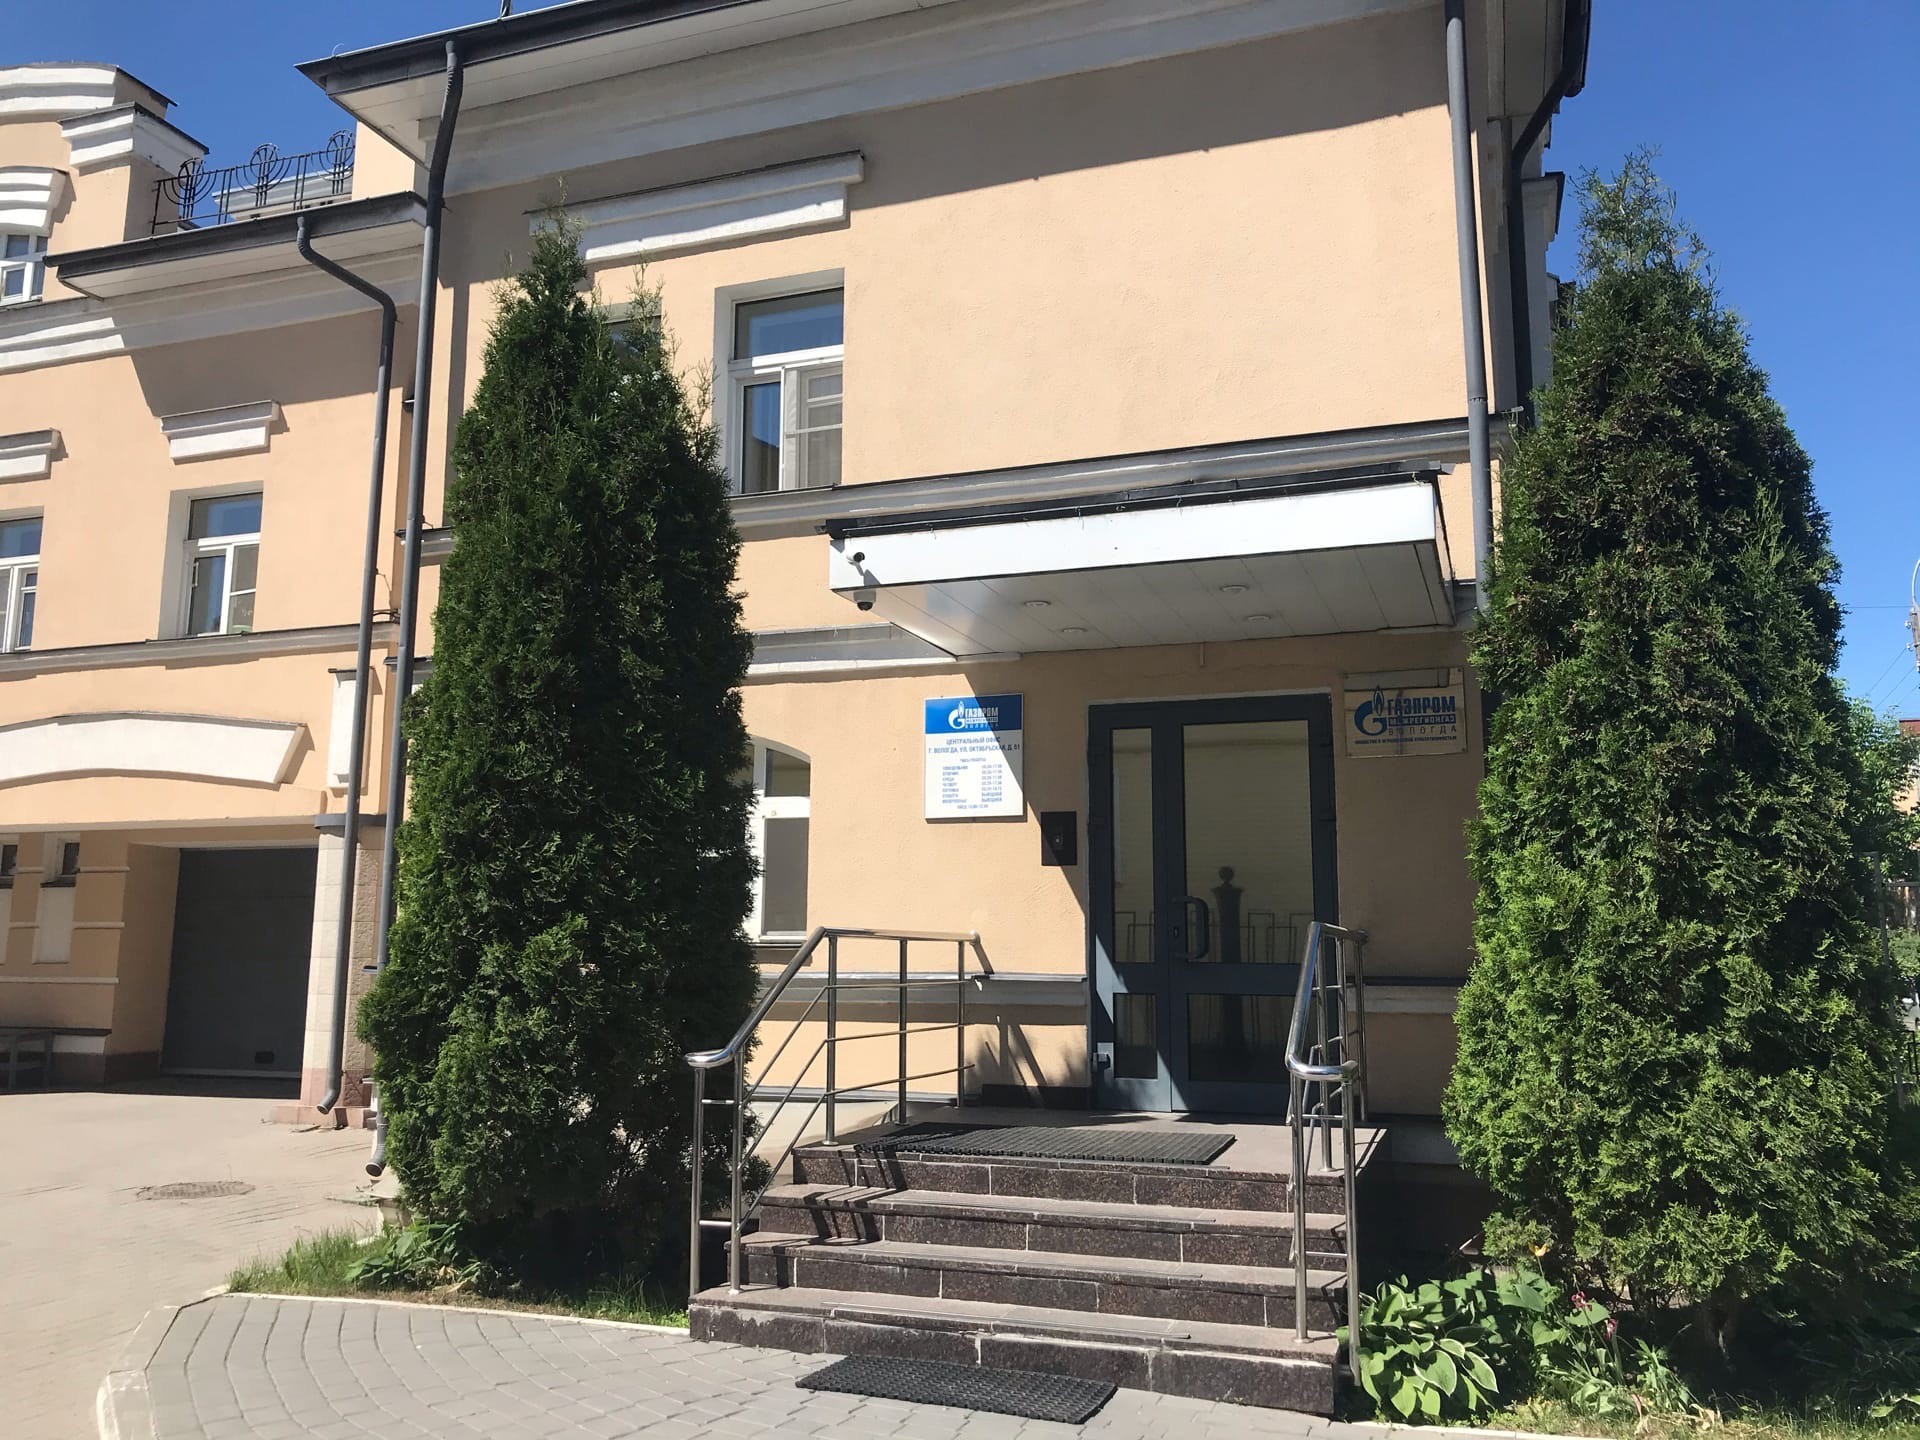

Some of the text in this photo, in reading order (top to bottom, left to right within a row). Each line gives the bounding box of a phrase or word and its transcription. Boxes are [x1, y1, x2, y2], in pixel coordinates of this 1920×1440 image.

[1387, 696, 1456, 715] ГАЗПРОМ
[965, 707, 999, 718] ГАЗПРОМ
[946, 737, 985, 746] ЦЕНТРАЛЬНЫЙ
